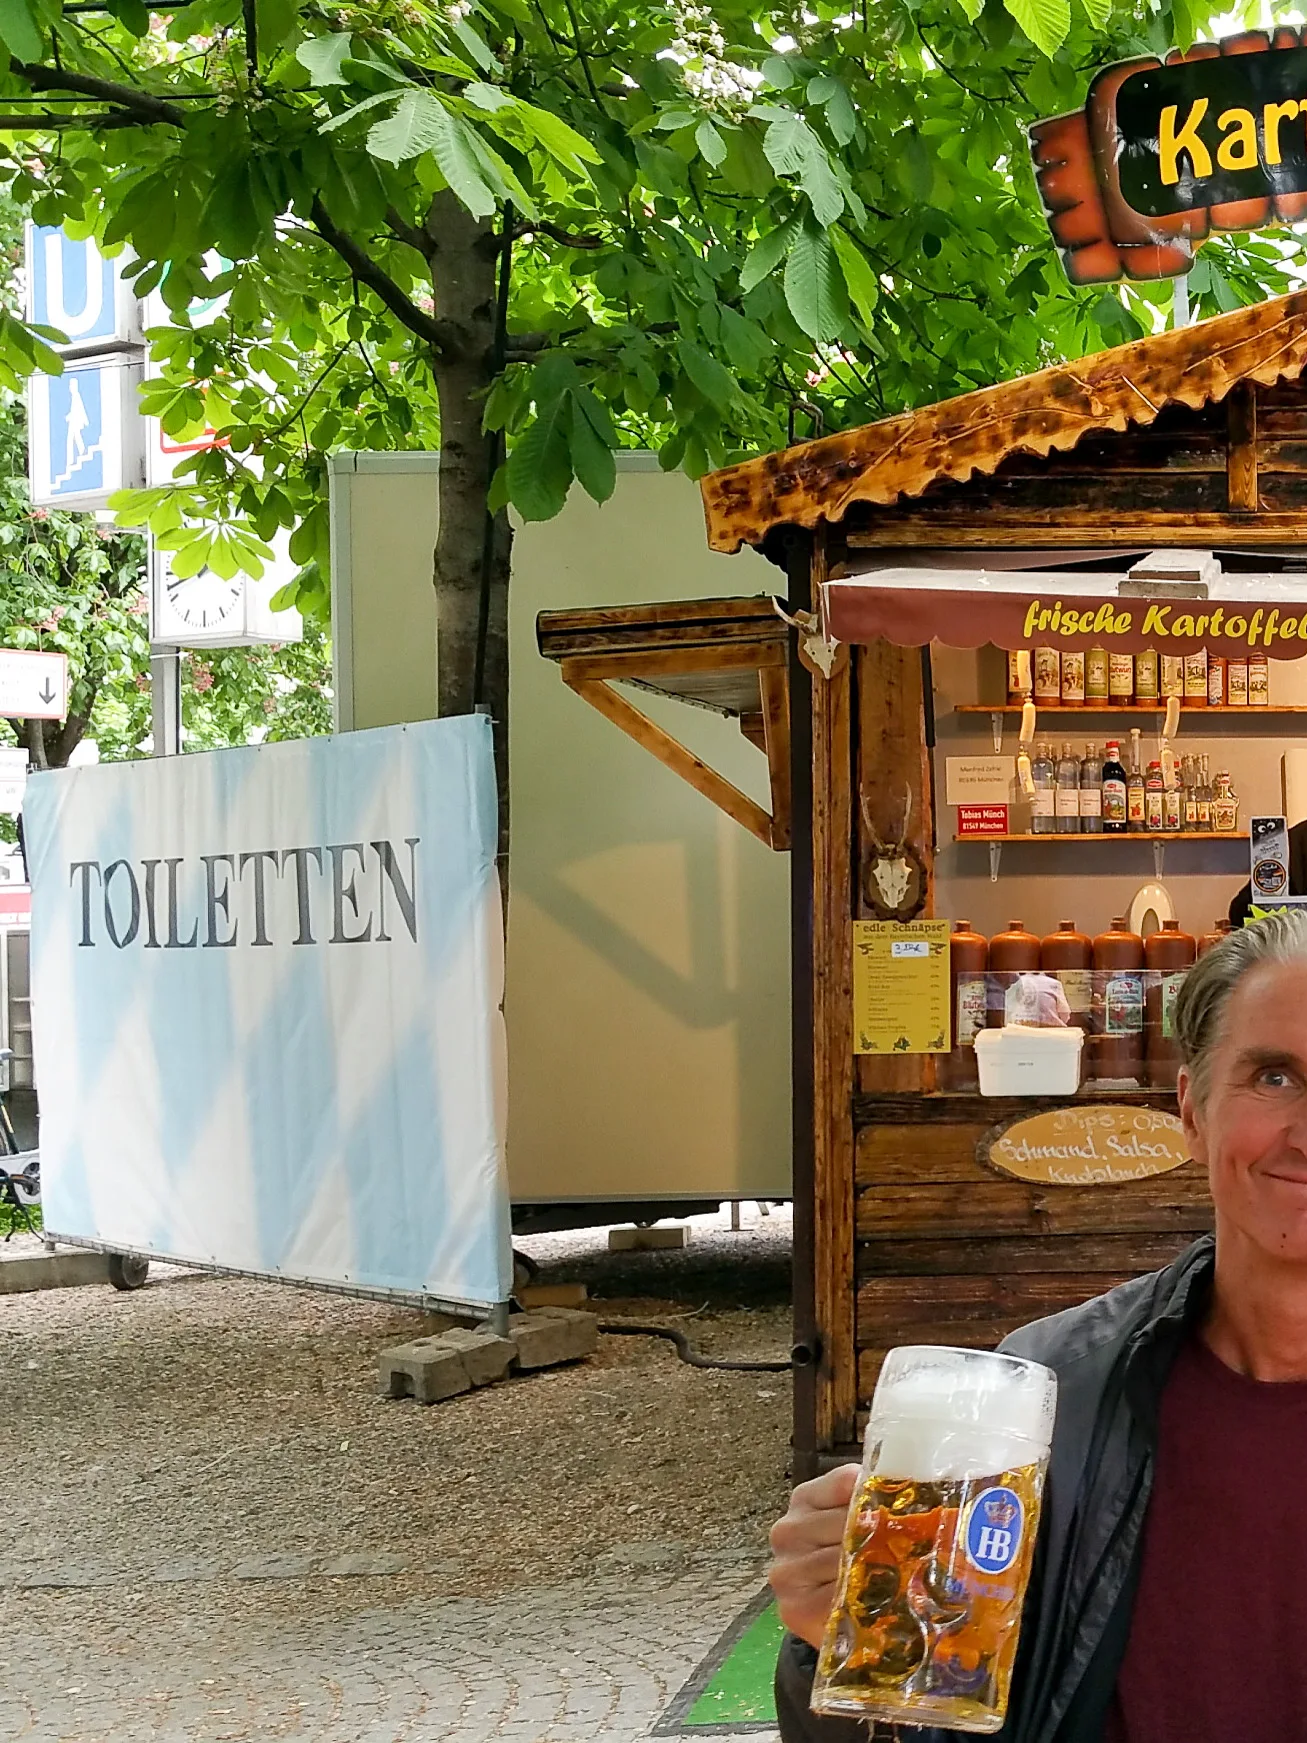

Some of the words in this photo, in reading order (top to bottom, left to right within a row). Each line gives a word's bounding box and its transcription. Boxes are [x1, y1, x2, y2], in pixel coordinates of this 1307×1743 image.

[45, 233, 103, 338] U
[1023, 600, 1132, 638] frische
[960, 810, 981, 819] Tobias
[983, 809, 1005, 818] Münch
[979, 821, 1004, 829] München
[69, 837, 421, 949] TOILETTEN
[863, 923, 886, 933] edle
[892, 922, 943, 934] Schnäpse
[975, 1526, 1012, 1562] HB
